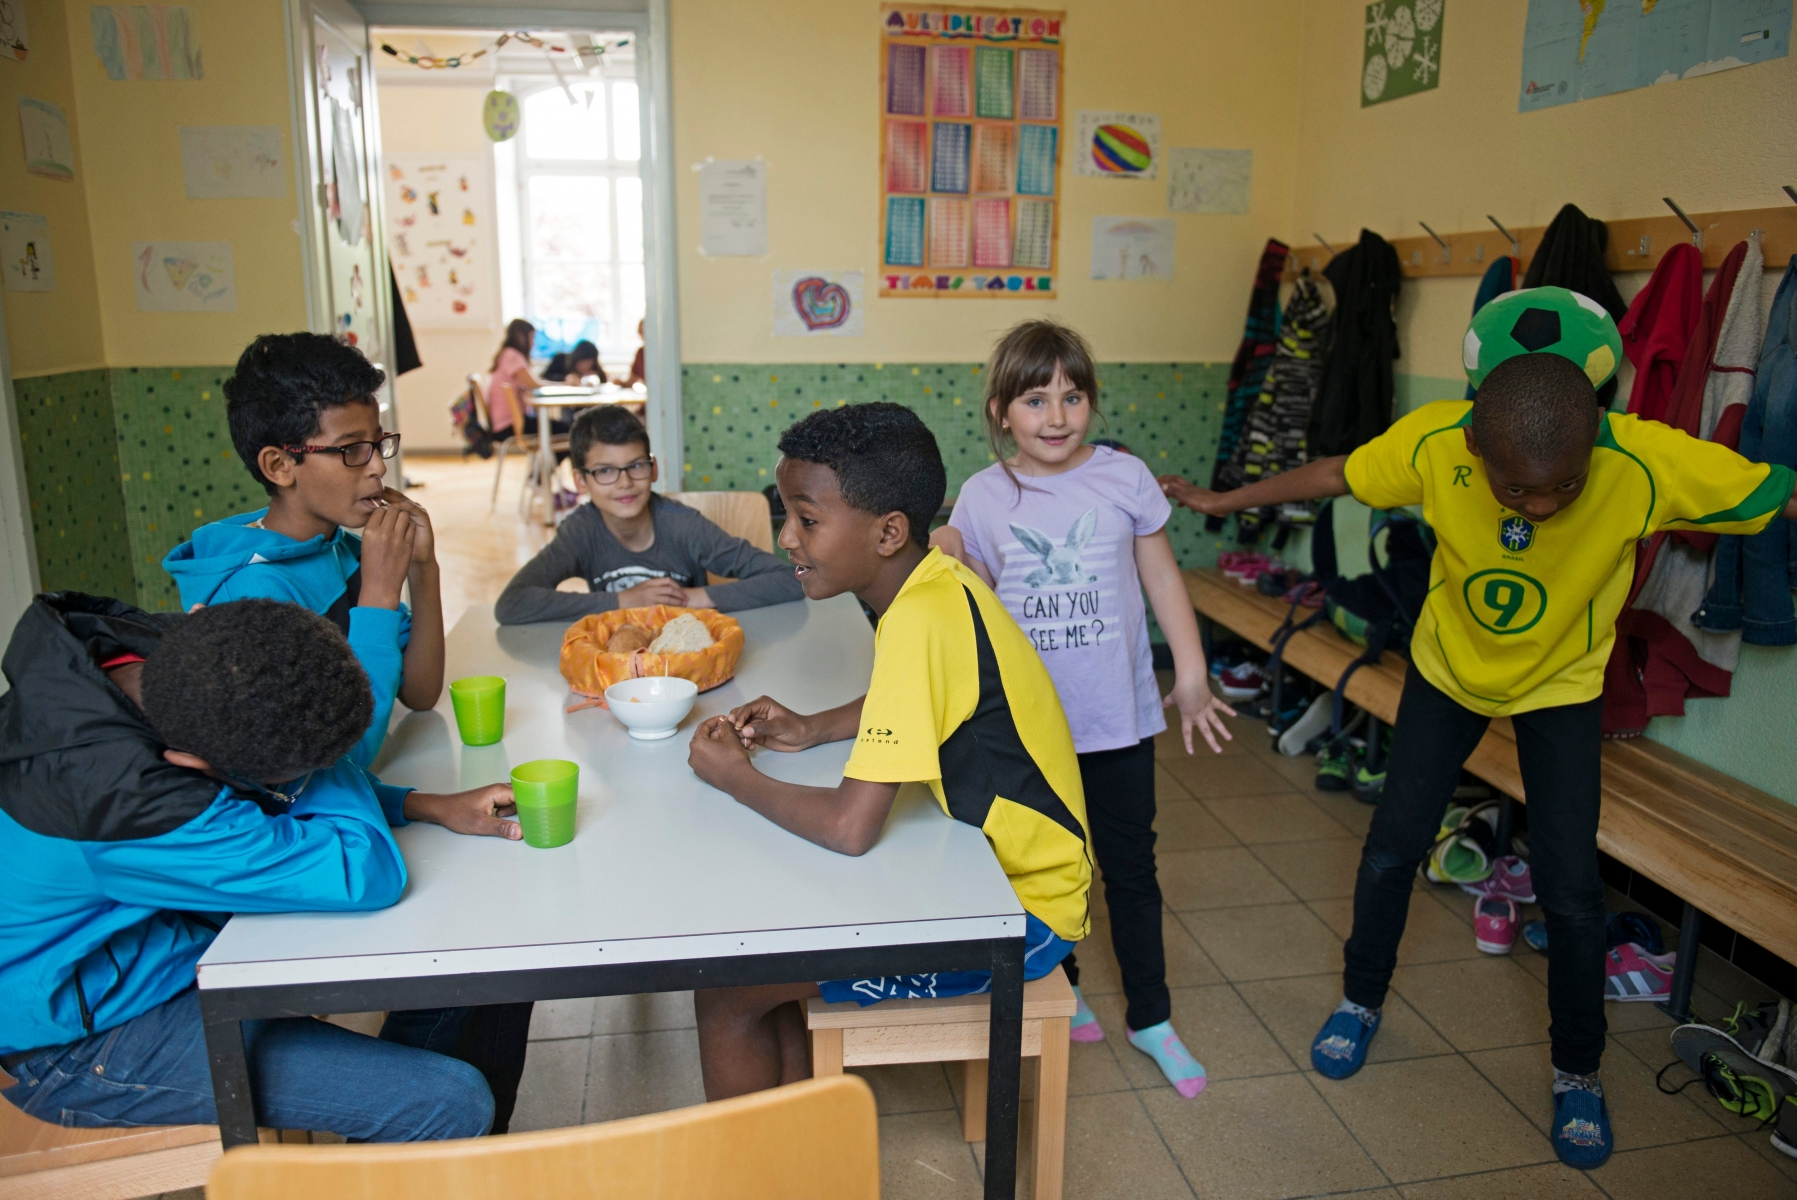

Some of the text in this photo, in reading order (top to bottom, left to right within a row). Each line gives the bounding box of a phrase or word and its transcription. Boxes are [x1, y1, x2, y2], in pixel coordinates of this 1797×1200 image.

[886, 10, 1061, 36] MULTIPLICATION
[885, 275, 1051, 291] TIMES TABLE
[1453, 465, 1472, 487] R
[1502, 554, 1525, 562] BRASIL
[1023, 590, 1099, 618] CAN YOU
[1484, 579, 1525, 628] 9
[1030, 619, 1104, 651] SEE ME?
